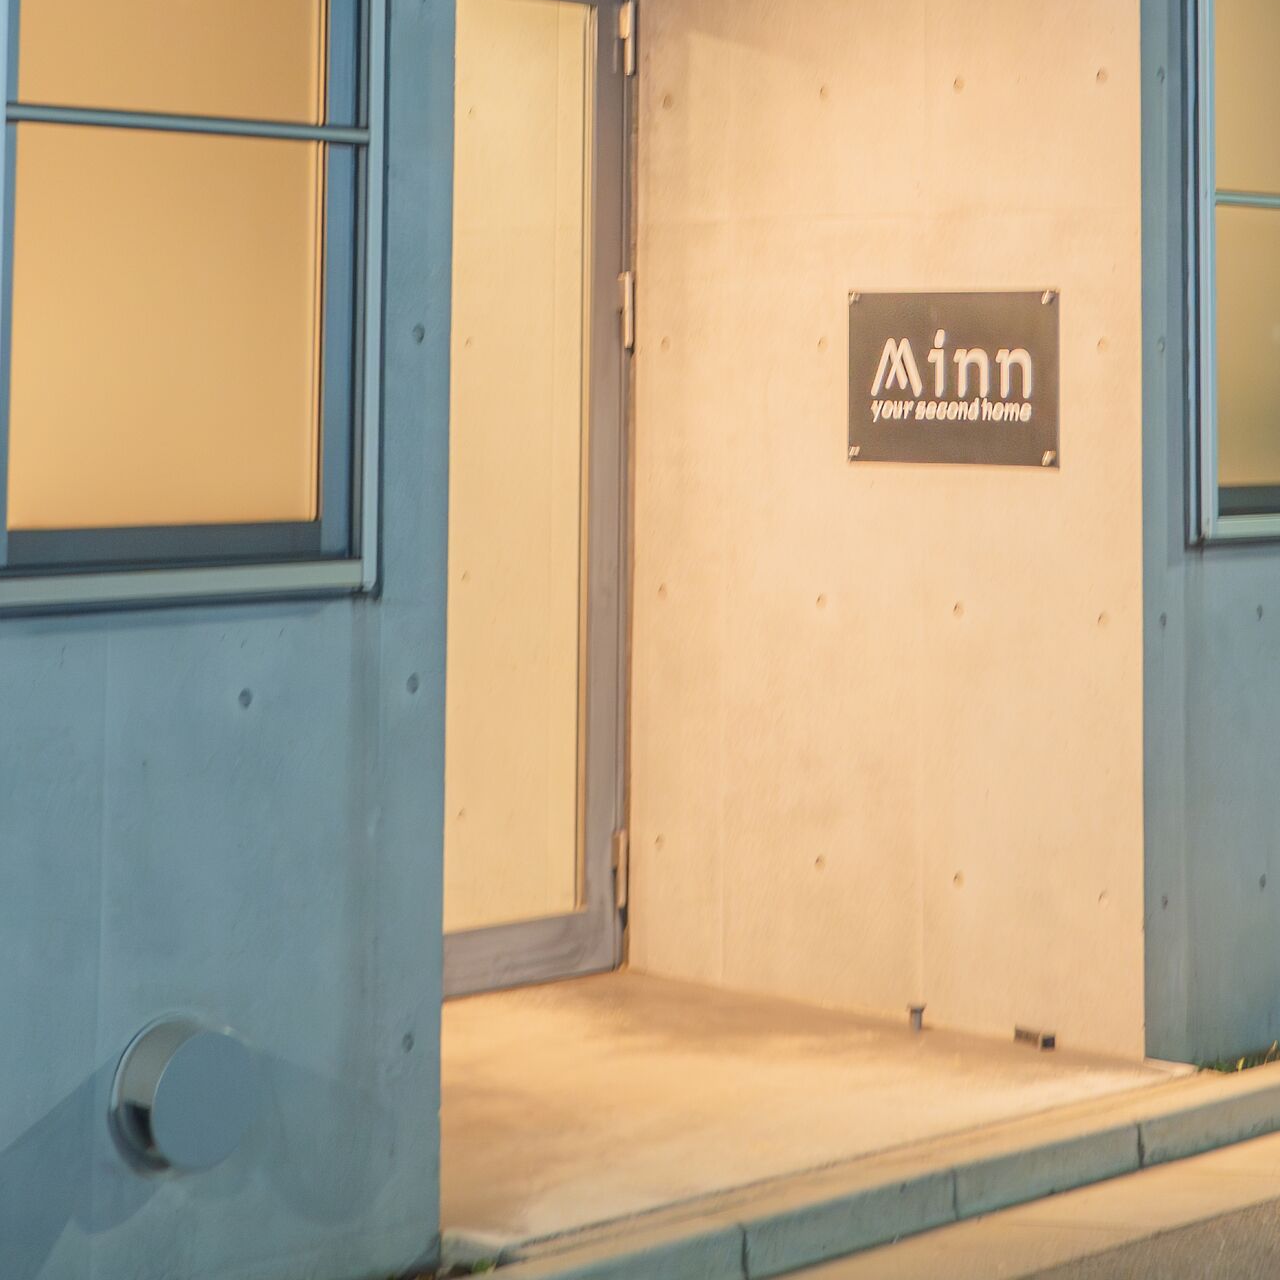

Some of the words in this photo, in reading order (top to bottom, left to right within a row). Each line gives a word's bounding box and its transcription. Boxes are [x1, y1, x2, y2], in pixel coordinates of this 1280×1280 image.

[871, 329, 1031, 399] Minn
[871, 400, 914, 422] your
[915, 398, 979, 421] second
[981, 398, 1032, 422] home
